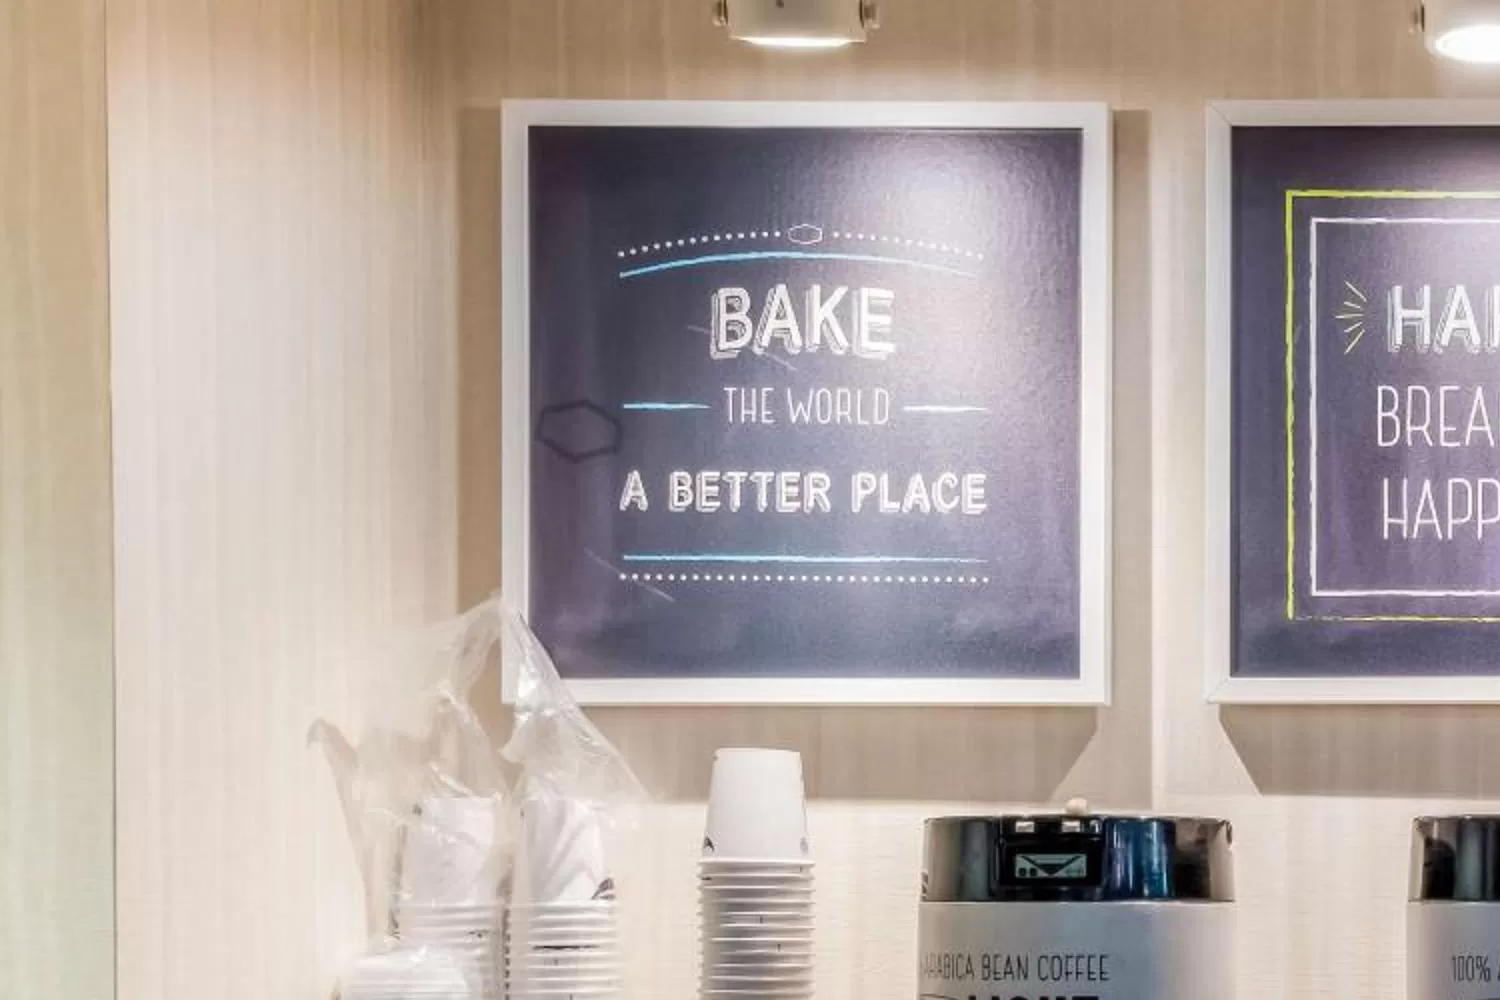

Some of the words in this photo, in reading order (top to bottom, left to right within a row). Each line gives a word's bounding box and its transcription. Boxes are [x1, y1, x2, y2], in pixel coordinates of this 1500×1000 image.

[710, 282, 897, 360] BAKE
[724, 387, 775, 425] THE
[786, 387, 890, 425] WORLD
[619, 470, 649, 512] A
[669, 470, 832, 513] BETTER
[851, 471, 988, 514] PLACE
[981, 954, 1029, 981] BEAN
[1037, 954, 1112, 982] COFFEE
[1451, 955, 1492, 983] 100%
